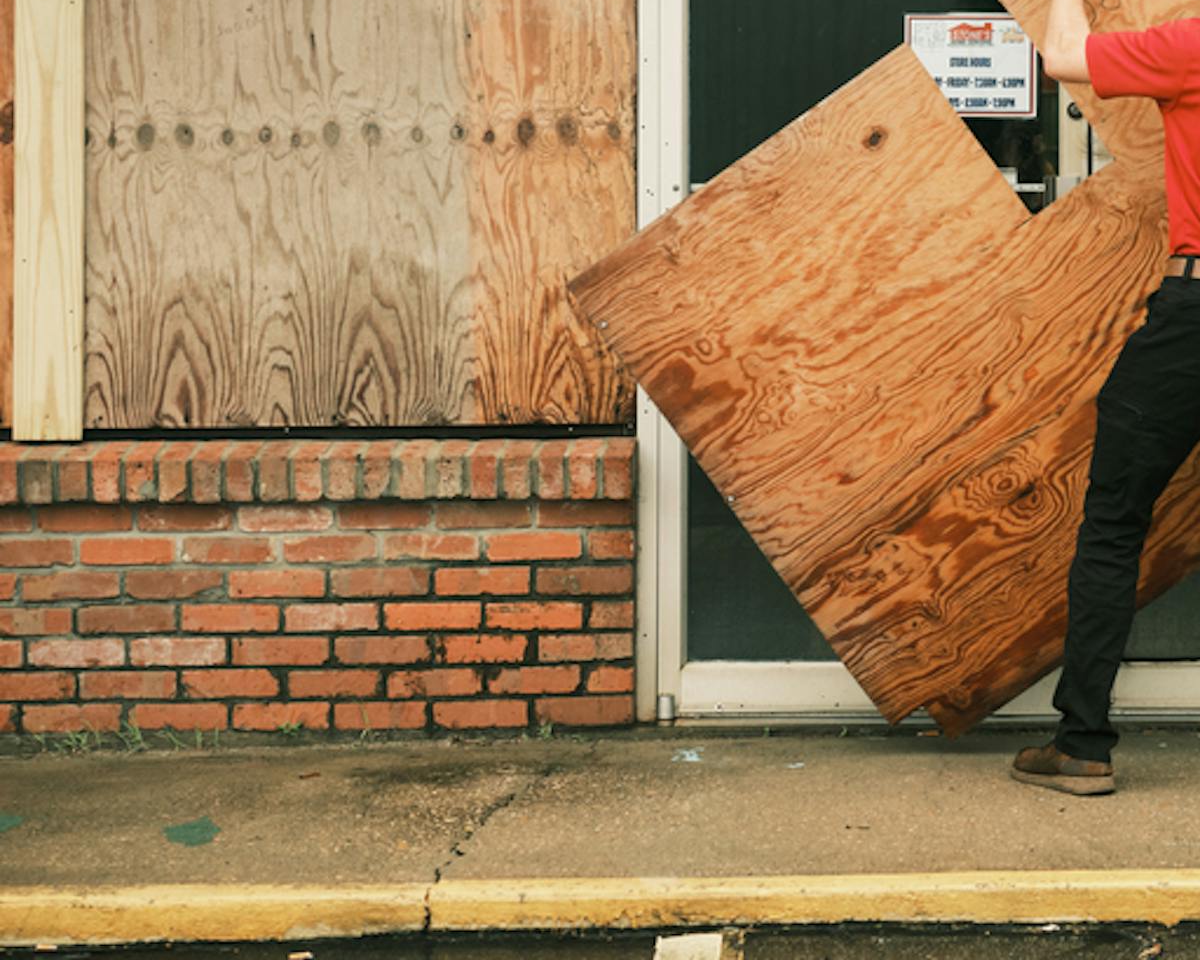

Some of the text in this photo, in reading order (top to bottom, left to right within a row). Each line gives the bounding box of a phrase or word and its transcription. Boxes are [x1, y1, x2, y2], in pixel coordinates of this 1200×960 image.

[950, 57, 991, 67] STORE HOURS
[947, 77, 970, 87] FRIDAY
